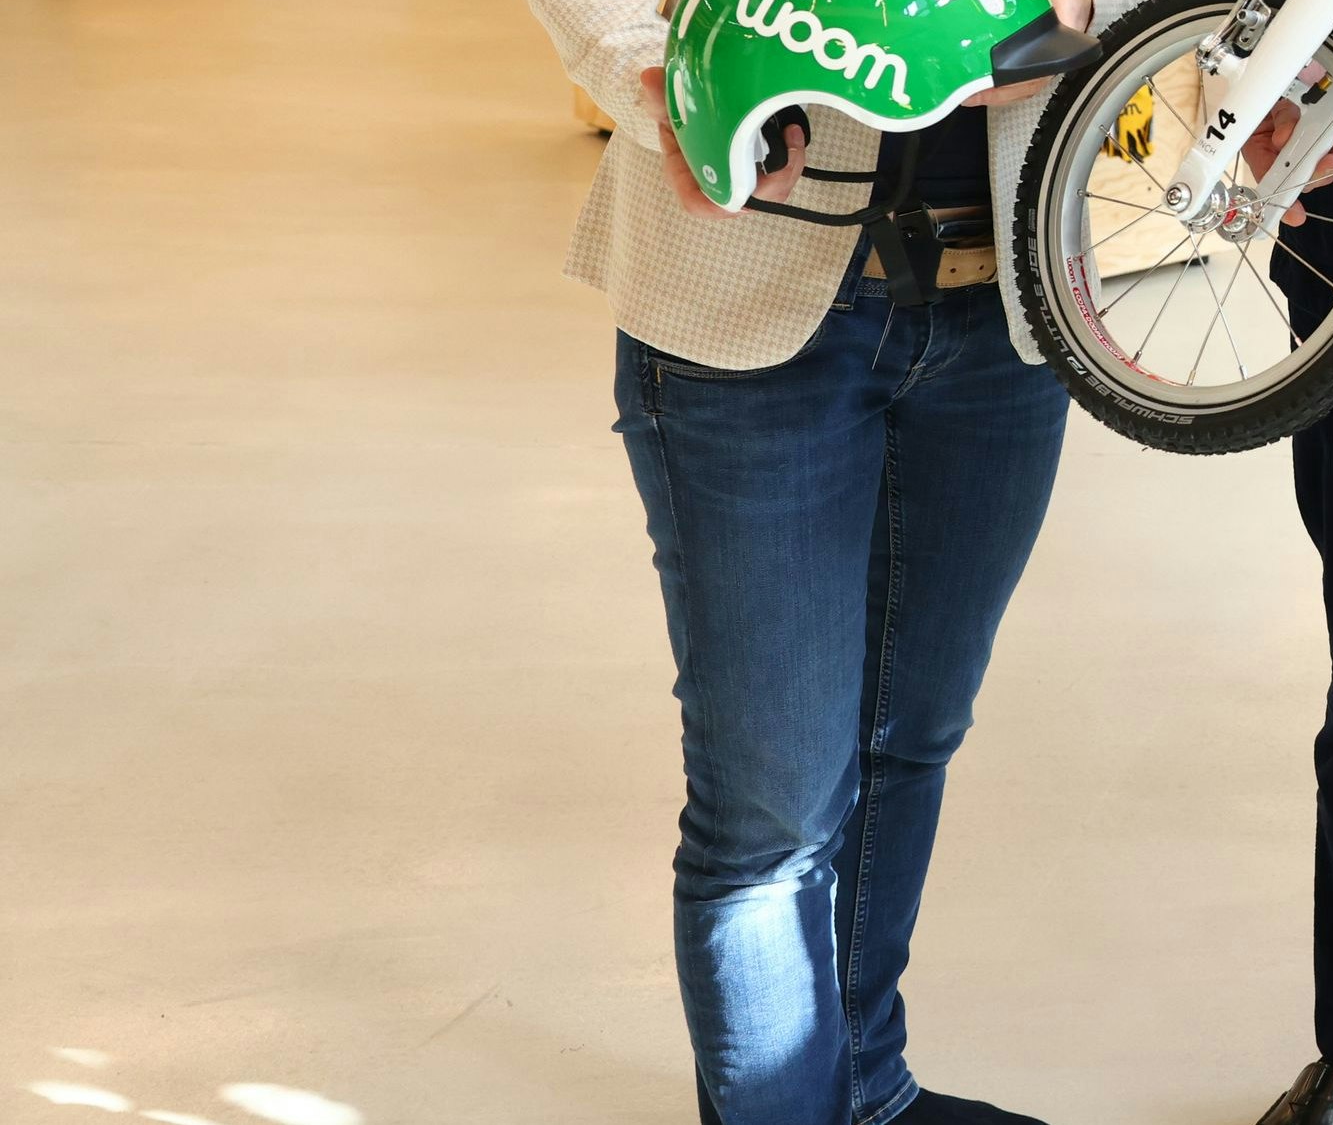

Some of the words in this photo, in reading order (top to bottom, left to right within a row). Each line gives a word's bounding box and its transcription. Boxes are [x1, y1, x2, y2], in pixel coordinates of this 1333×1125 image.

[1206, 108, 1237, 141] 14
[1027, 236, 1040, 277] JOE
[1033, 283, 1070, 358] LITTLE
[1085, 371, 1198, 425] SCHWALBE
